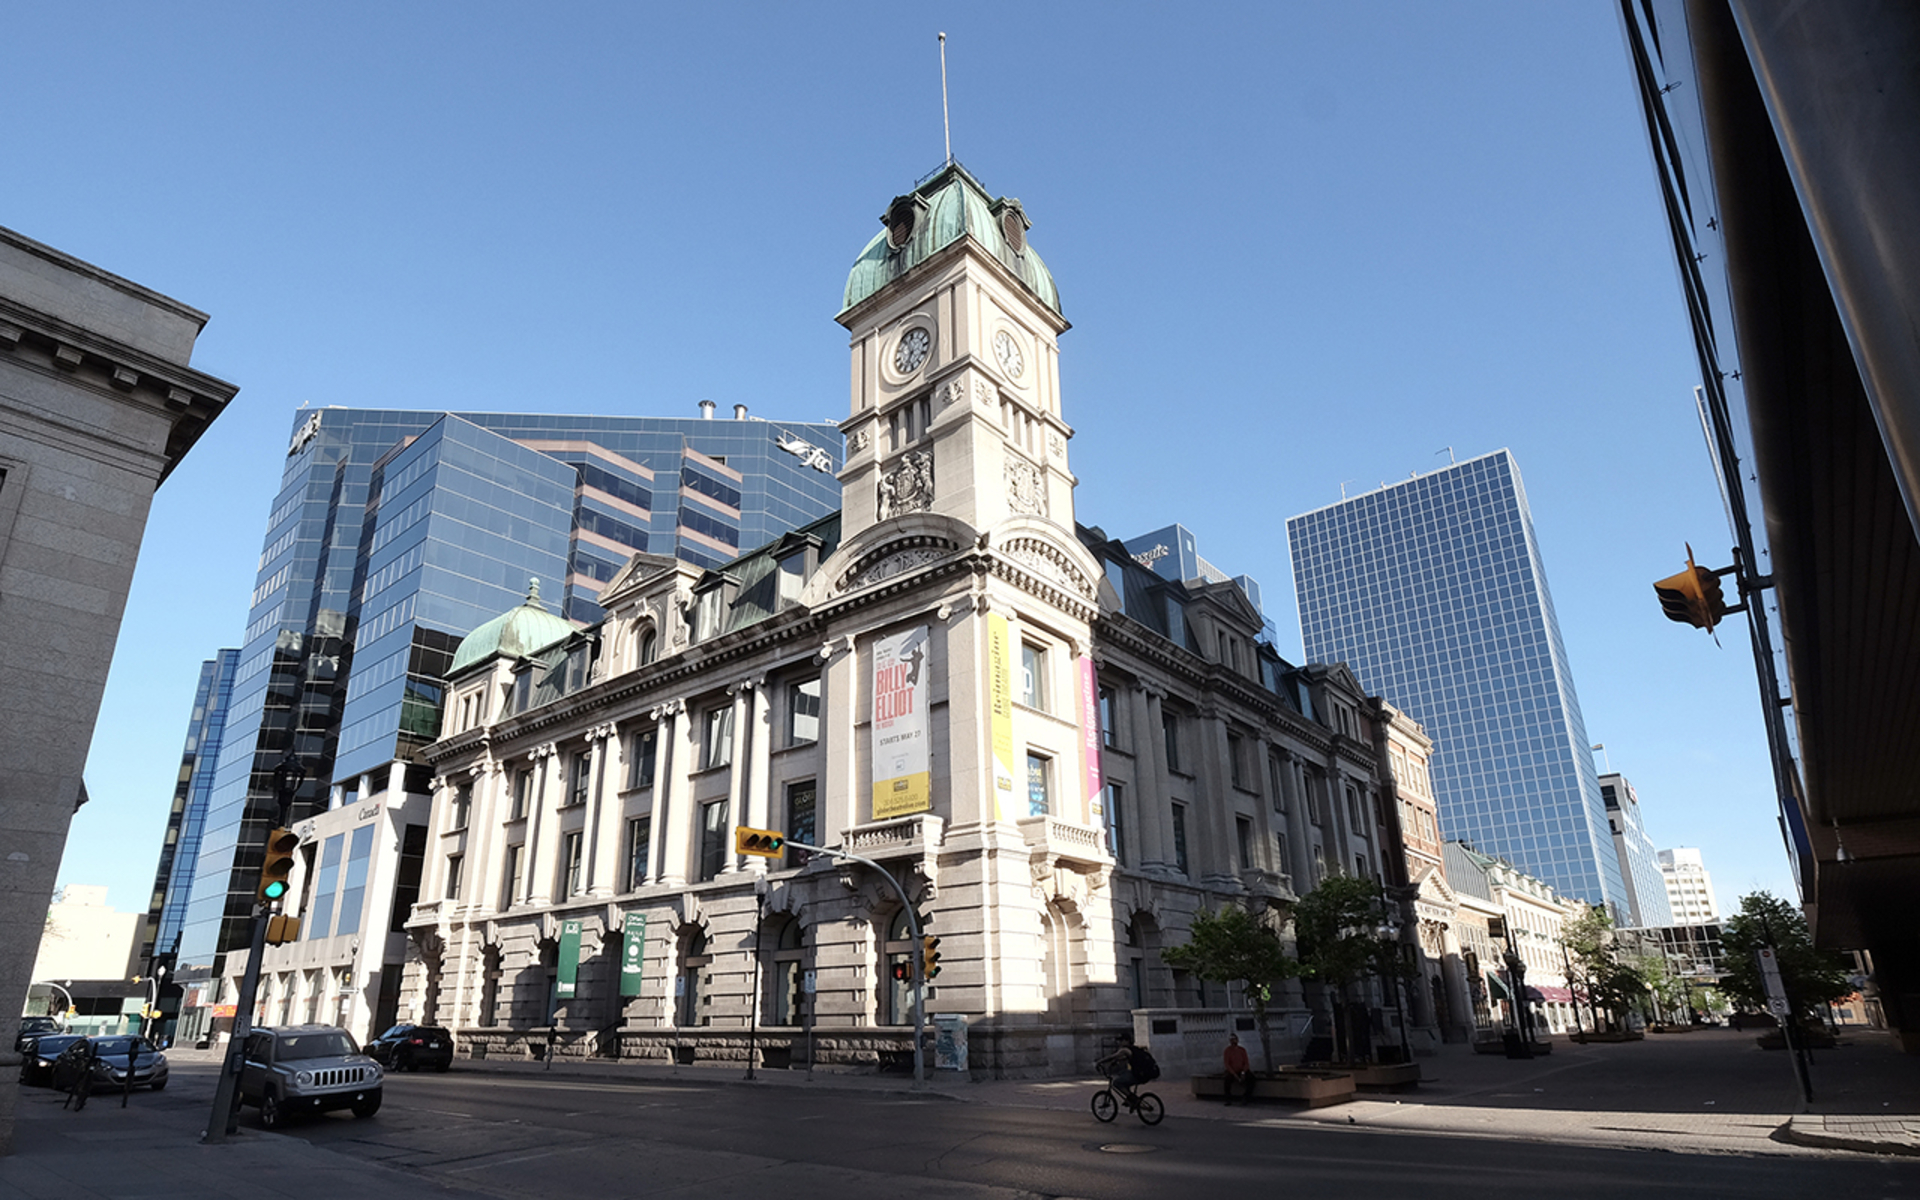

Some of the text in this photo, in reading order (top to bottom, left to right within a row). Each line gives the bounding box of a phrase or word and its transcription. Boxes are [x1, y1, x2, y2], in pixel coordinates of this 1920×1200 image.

[876, 662, 908, 696] BILLY
[875, 687, 914, 722] ELLIOT
[879, 735, 900, 746] STARTS
[900, 732, 914, 741] MAY
[358, 803, 381, 821] Canada
